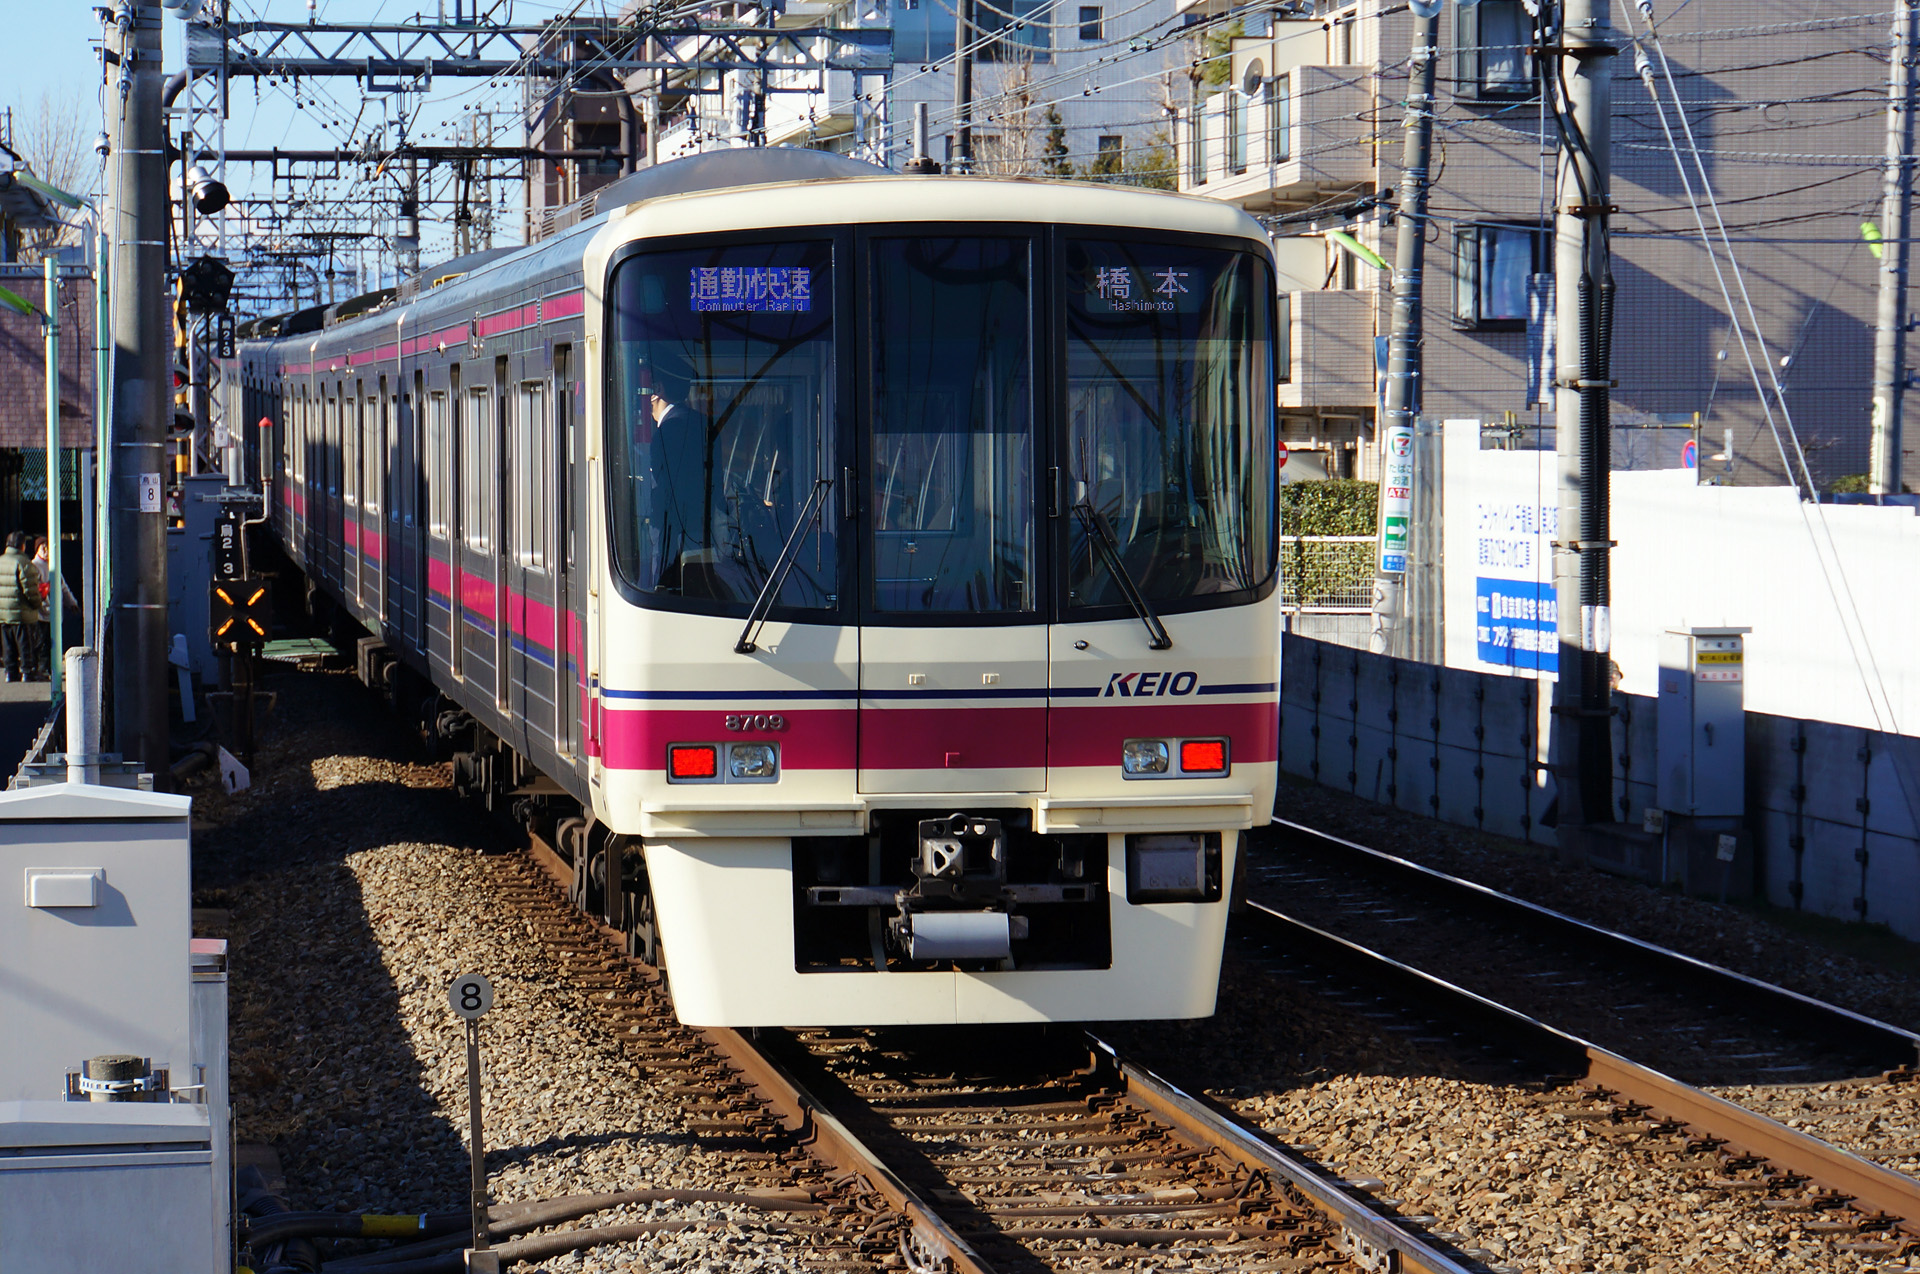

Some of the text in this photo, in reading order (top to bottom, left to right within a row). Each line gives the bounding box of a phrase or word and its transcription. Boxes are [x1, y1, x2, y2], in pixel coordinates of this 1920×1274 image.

[690, 267, 811, 300] 通勤快速
[1096, 266, 1189, 299] 橋本
[697, 300, 803, 312] Commuter Rapid
[1109, 299, 1175, 311] Hashimoto
[147, 487, 155, 501] 8
[1103, 671, 1198, 698] KEIO
[725, 714, 785, 731] 8709
[460, 982, 483, 1011] 8
